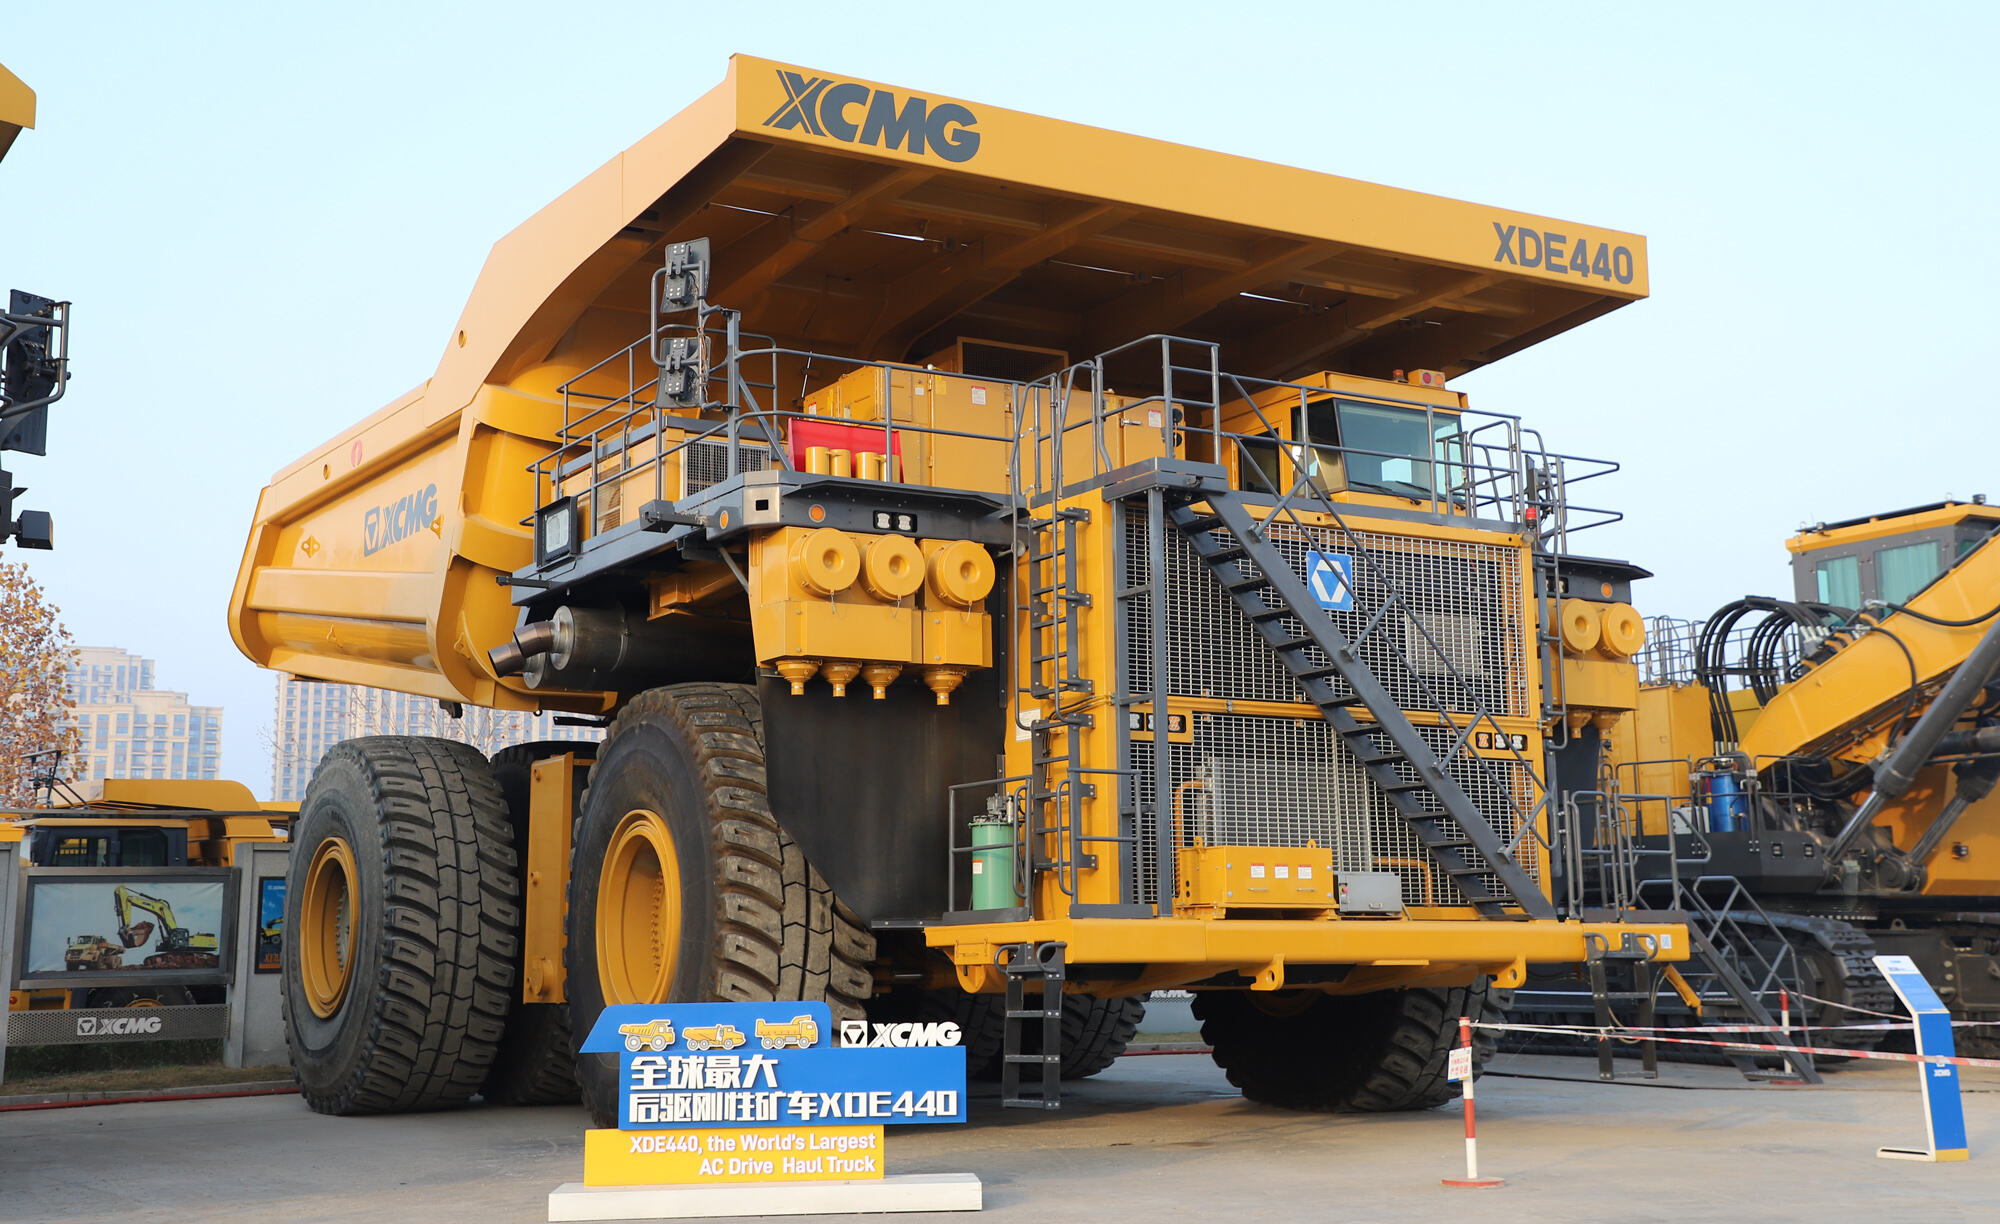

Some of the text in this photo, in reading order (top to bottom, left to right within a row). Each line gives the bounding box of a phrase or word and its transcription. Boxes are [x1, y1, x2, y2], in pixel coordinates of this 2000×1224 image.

[762, 69, 981, 163] XCMG
[1492, 221, 1634, 285] XDE440
[379, 483, 438, 550] XCMG
[96, 1016, 162, 1036] XCMG
[868, 1021, 962, 1048] XCMG
[630, 1054, 779, 1091] 全球最大
[630, 1132, 877, 1155] XDE440, the World's Largest
[699, 1155, 877, 1175] AC Drive Haul Truck
